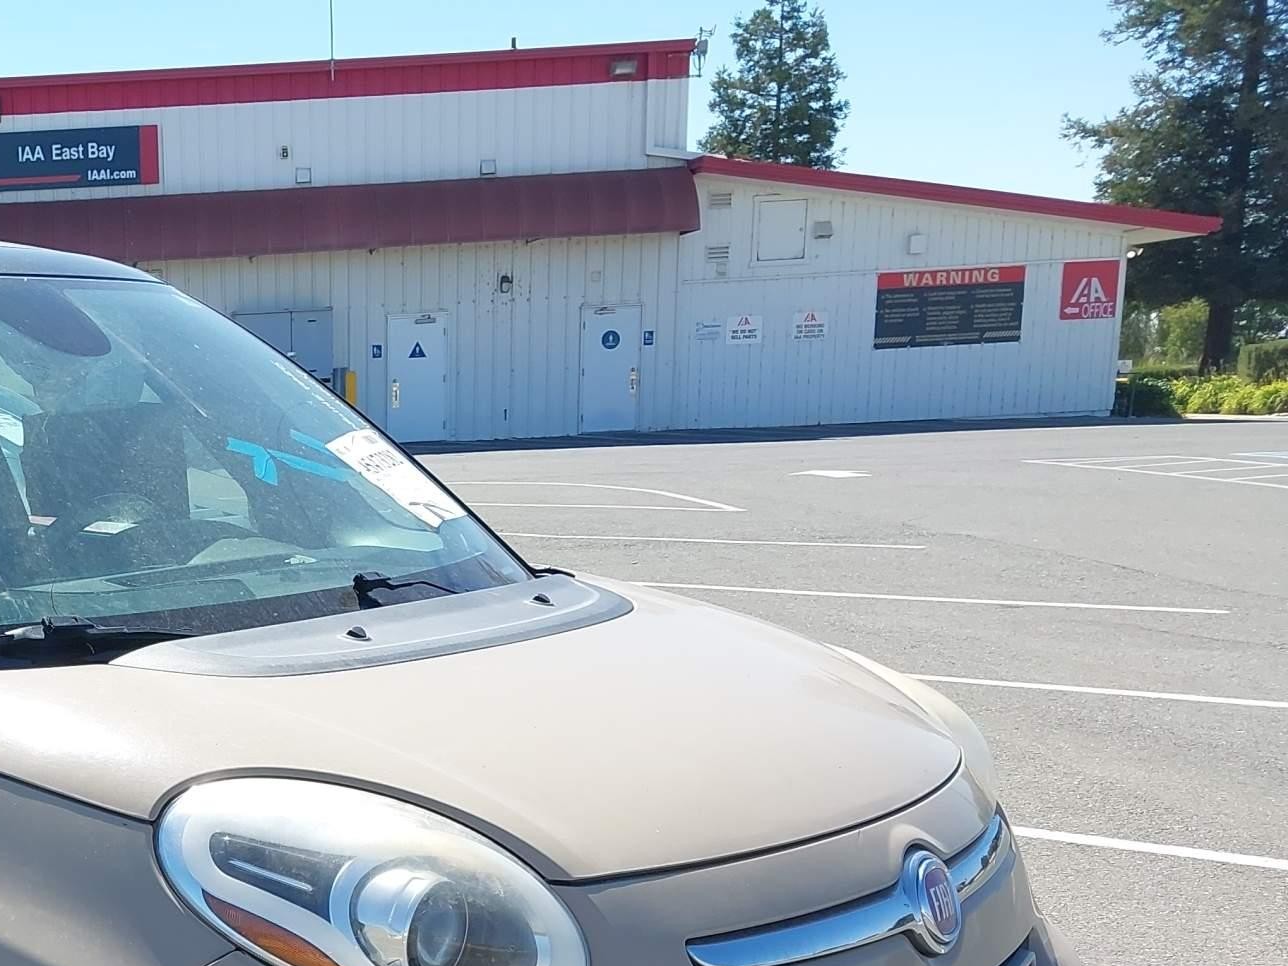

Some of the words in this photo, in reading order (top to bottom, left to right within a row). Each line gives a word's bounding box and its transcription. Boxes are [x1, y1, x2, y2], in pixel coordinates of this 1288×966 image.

[17, 146, 45, 162] IAA
[52, 144, 84, 160] East
[87, 142, 115, 161] Bay
[903, 269, 1000, 287] WARNING
[1081, 302, 1114, 318] OFFICE
